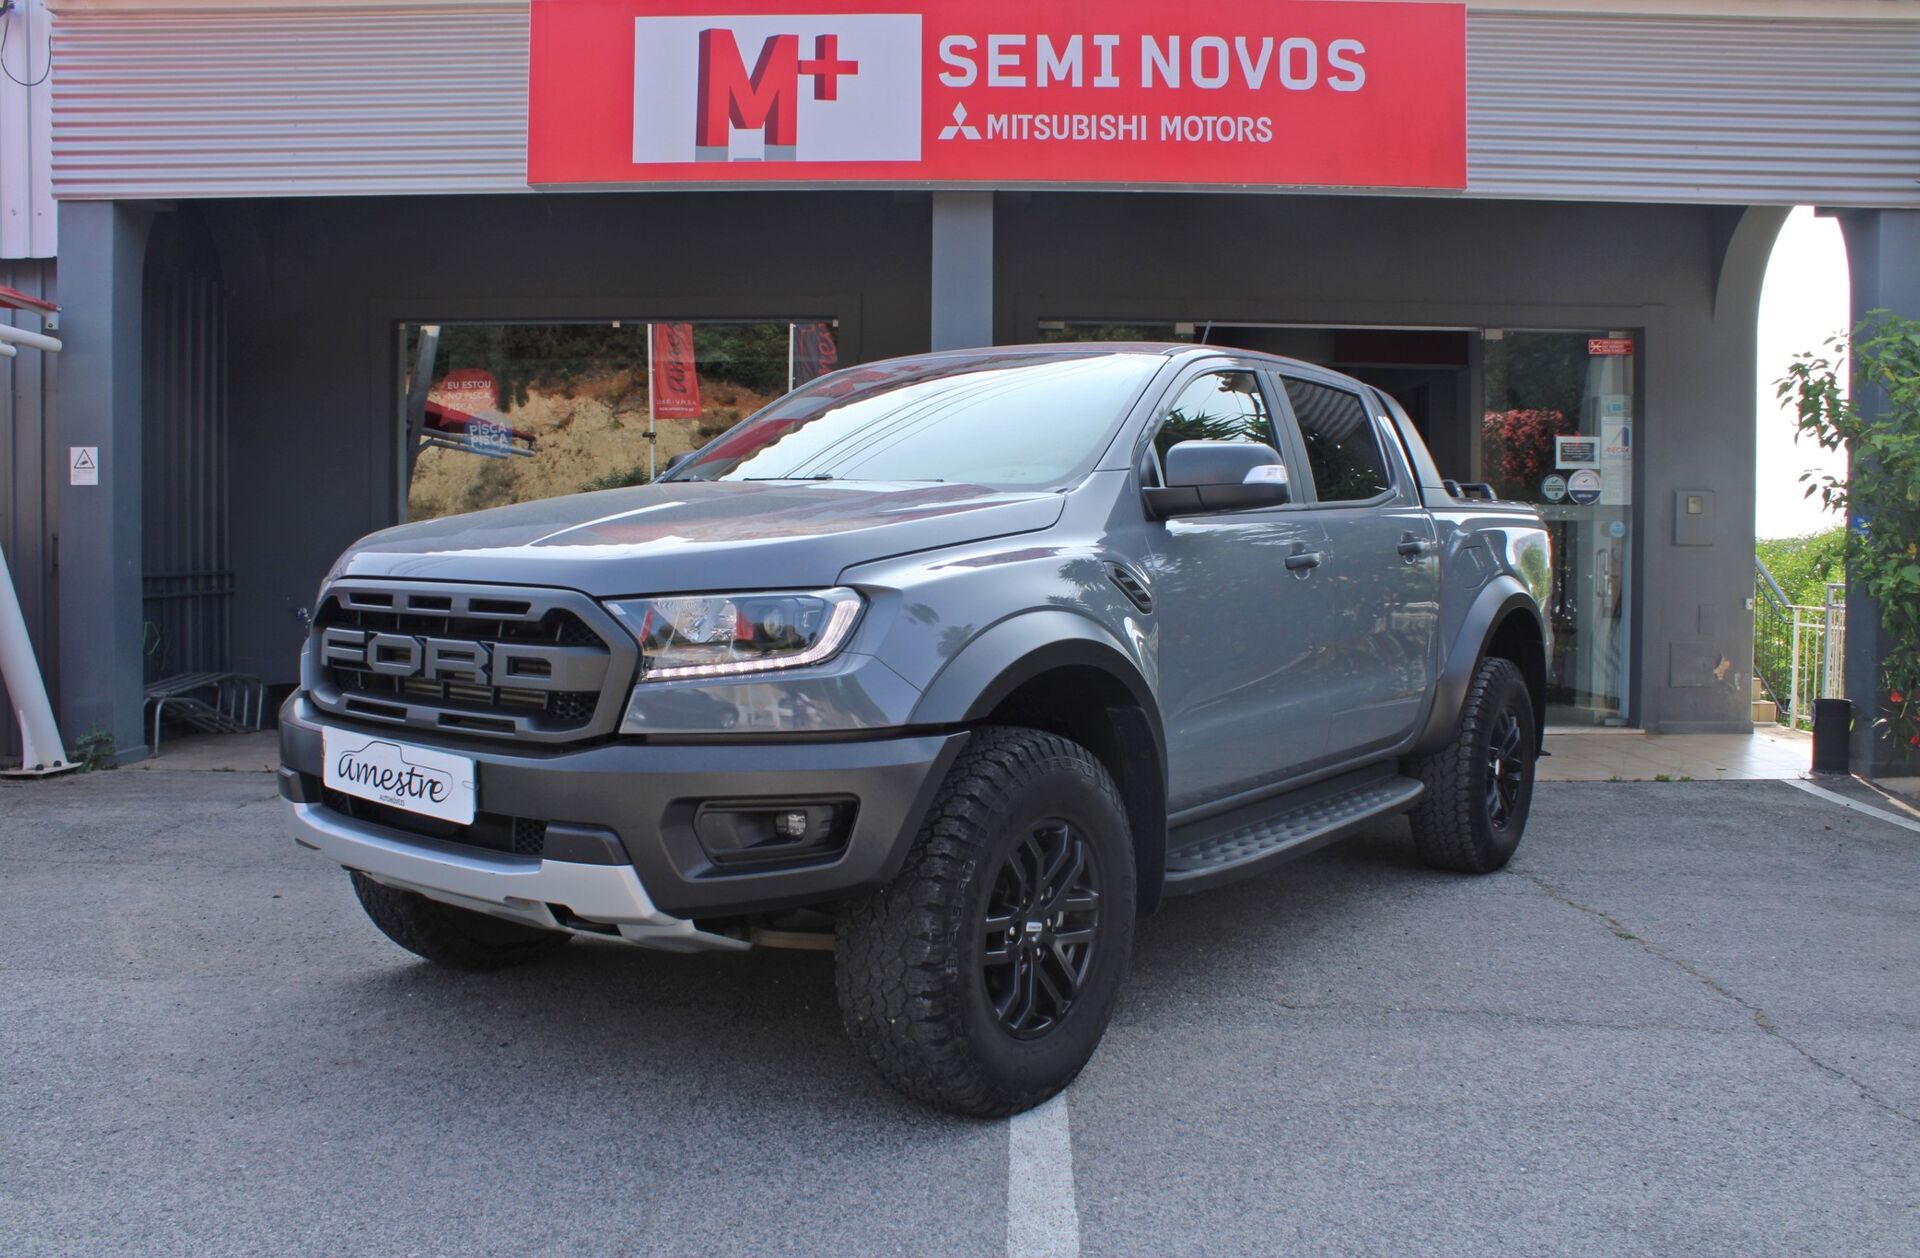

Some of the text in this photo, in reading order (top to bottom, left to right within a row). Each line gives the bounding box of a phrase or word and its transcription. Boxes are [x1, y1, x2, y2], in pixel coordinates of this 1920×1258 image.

[938, 34, 1366, 91] SEMI NOVOS
[987, 114, 1273, 142] MITSUBISHI MOTORS
[447, 380, 492, 389] EU ESTOU
[447, 391, 491, 400] NO PISCA
[321, 626, 560, 692] FORD
[338, 753, 448, 803] amestre
